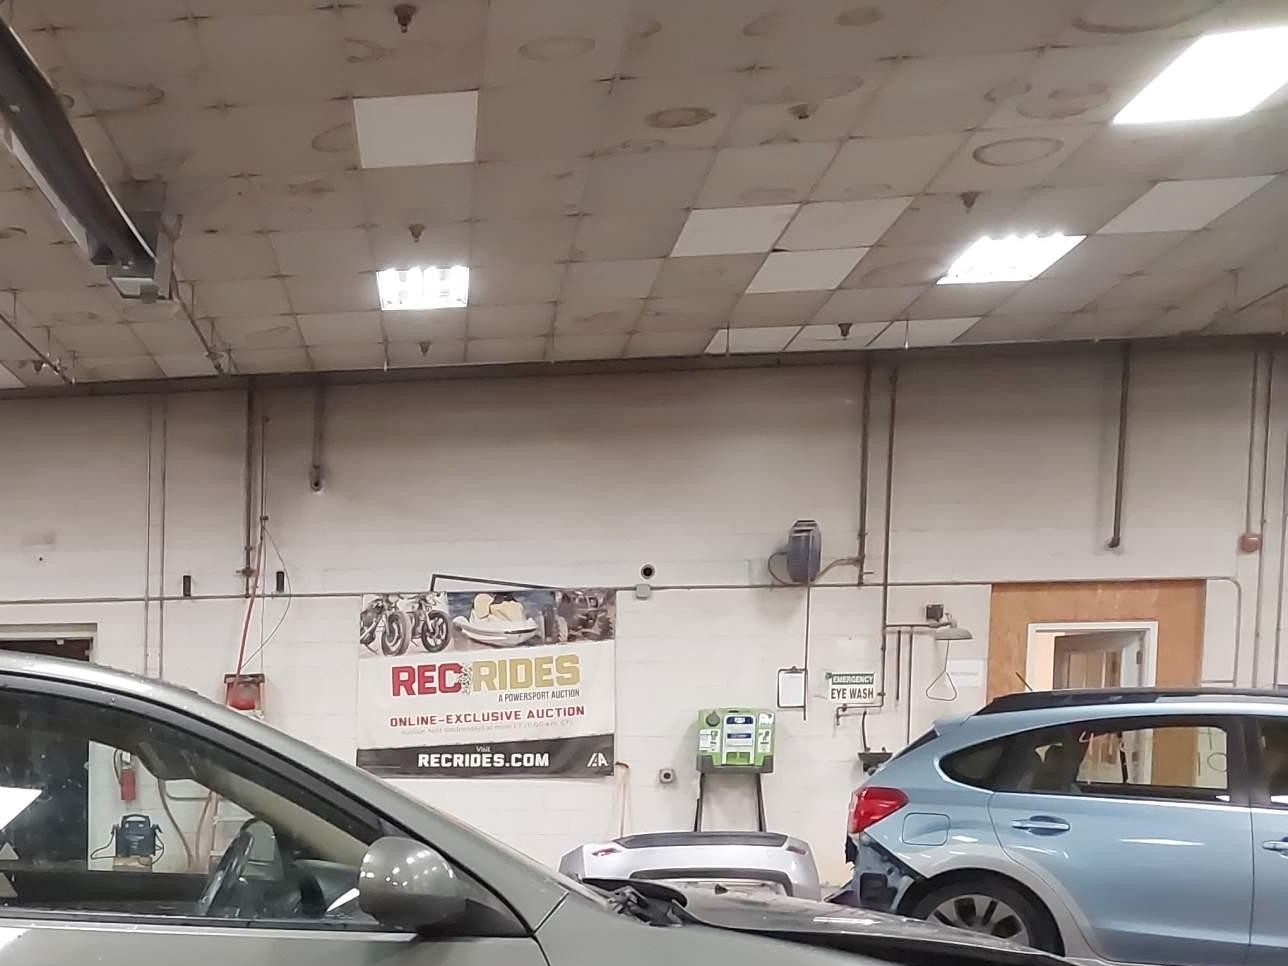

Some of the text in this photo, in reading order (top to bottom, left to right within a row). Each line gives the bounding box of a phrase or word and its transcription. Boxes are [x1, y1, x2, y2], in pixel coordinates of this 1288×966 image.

[391, 655, 581, 697] REC RIDES
[832, 674, 874, 684] EMERGENCY
[498, 688, 580, 702] A POWERSPORT AUCTION
[831, 688, 874, 699] EYE WASH
[390, 710, 521, 728] ONLINE-EXCLUSIVE
[526, 706, 585, 721] AUCTION
[418, 753, 549, 768] RECRIDES.COM
